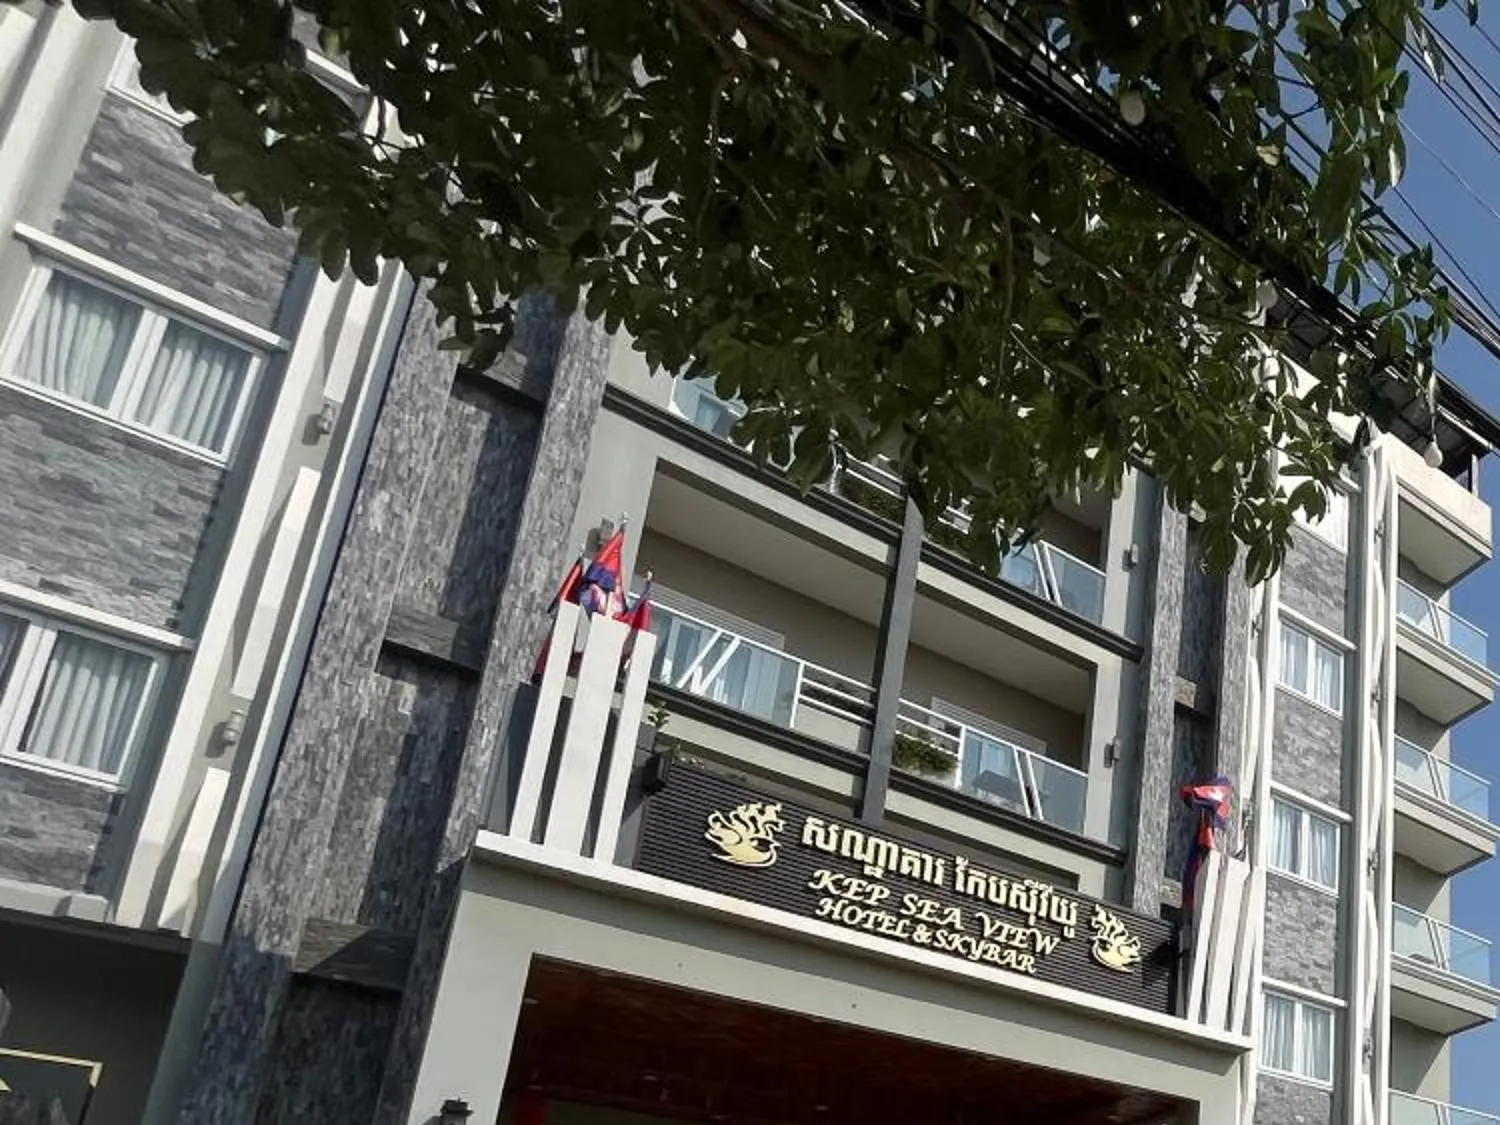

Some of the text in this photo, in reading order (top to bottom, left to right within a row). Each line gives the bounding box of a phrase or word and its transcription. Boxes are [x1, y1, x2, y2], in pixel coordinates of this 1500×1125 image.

[808, 869, 1060, 955] KEP SEA VIEW
[816, 897, 910, 938] HOTEL
[933, 929, 1037, 974] SKYBAR
